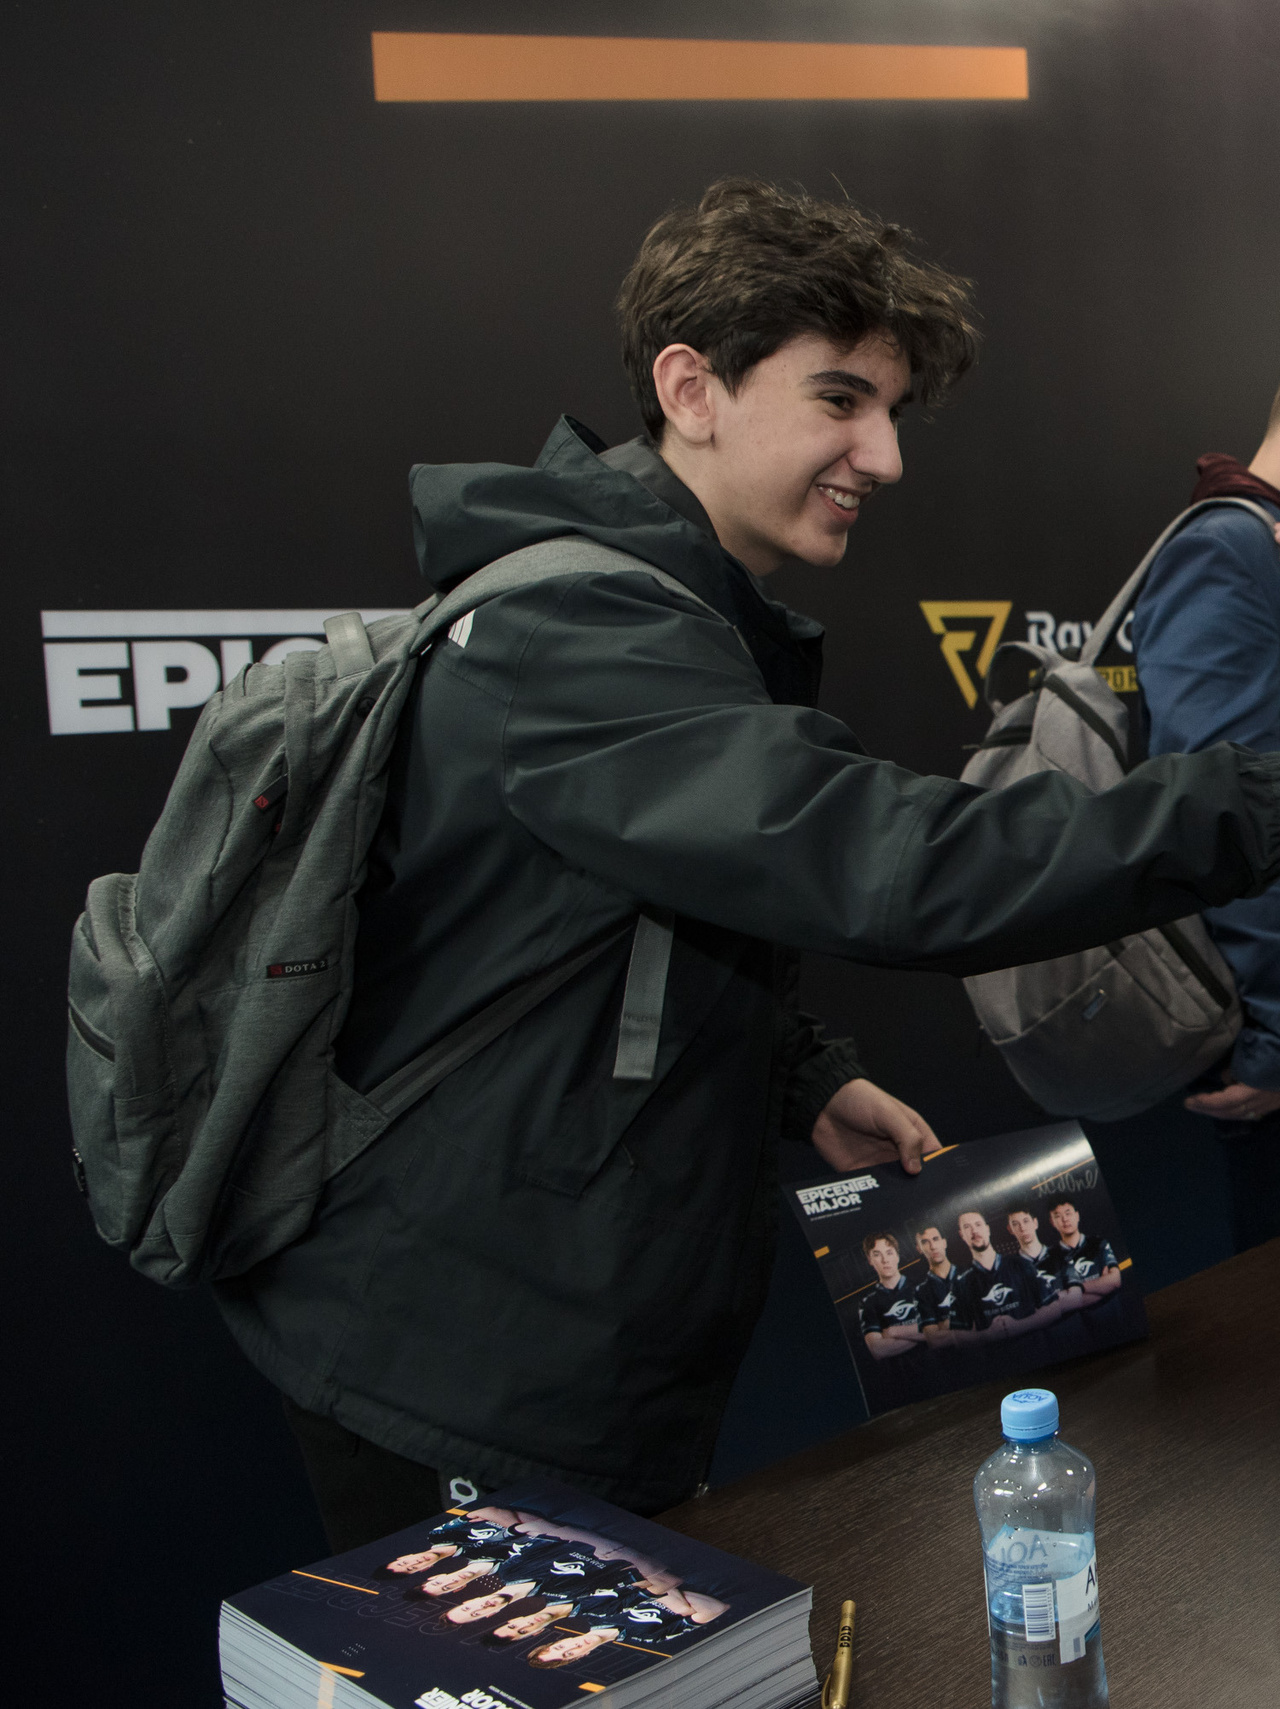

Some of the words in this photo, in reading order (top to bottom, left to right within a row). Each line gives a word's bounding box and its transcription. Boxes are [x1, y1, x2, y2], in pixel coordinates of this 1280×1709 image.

[285, 963, 317, 973] DOTA
[797, 1177, 880, 1204] EPICENTER
[803, 1193, 862, 1216] MAJOR
